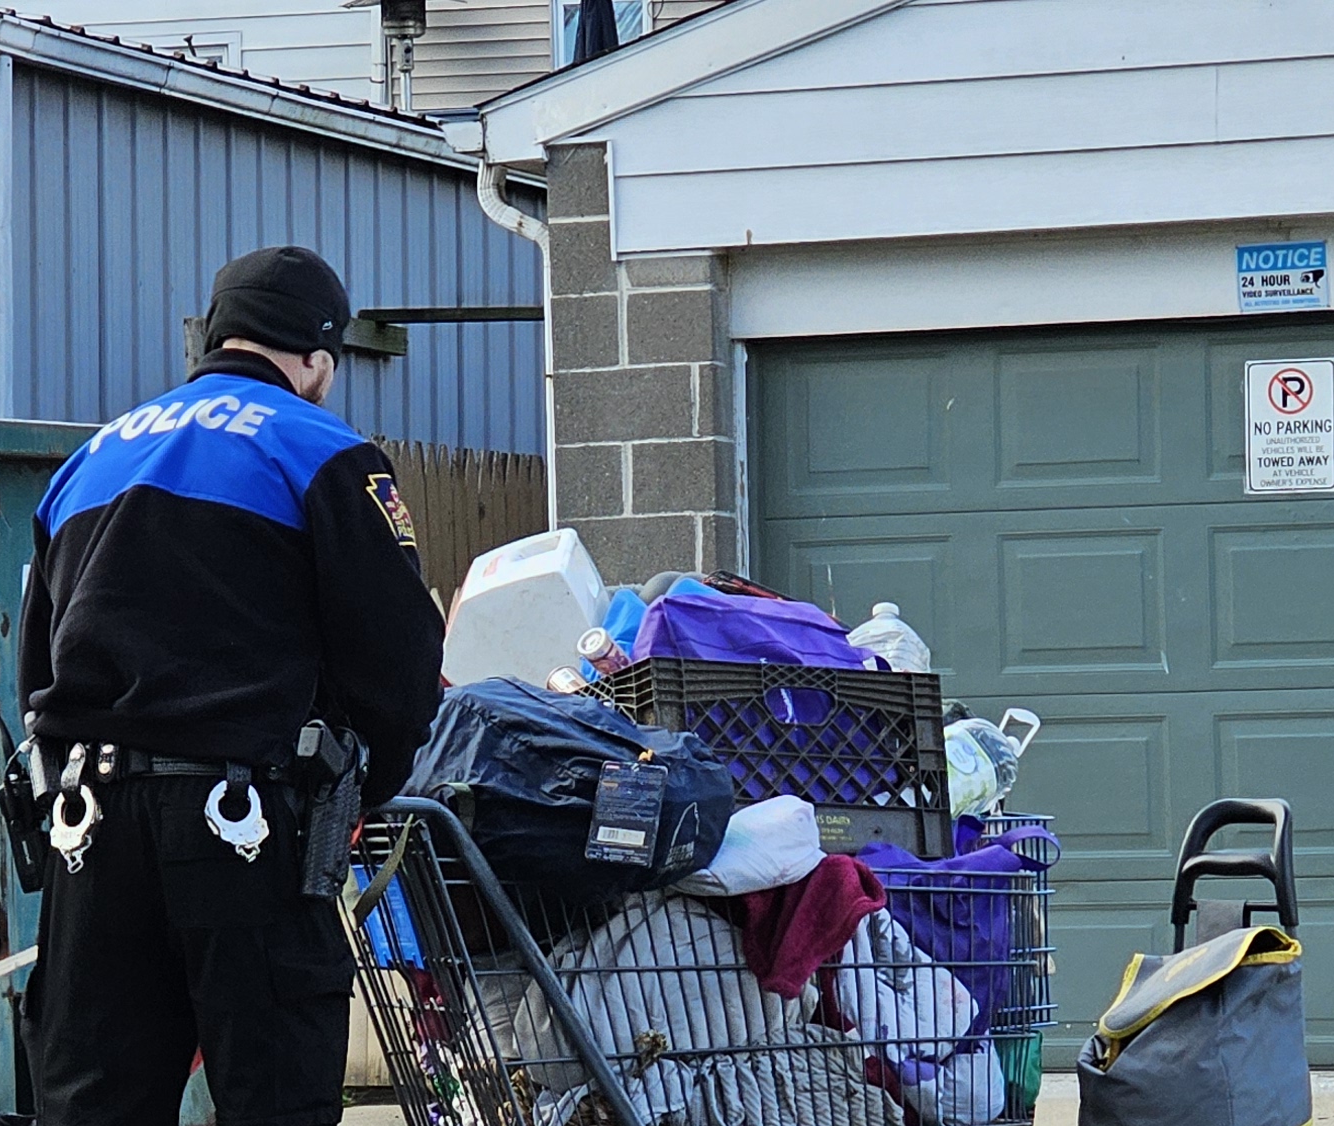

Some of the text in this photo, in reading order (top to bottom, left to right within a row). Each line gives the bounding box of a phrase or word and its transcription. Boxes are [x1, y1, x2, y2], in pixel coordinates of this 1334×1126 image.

[1241, 247, 1323, 270] NOTICE
[1241, 274, 1291, 288] 24 HOUR
[1242, 287, 1314, 298] VIDEO SURVEILLANCE
[89, 395, 277, 455] POLICE
[1254, 419, 1332, 436] NO PARKING
[1266, 436, 1320, 445] UNAUTHORIZED
[1261, 446, 1295, 455] VEHICLES
[1315, 445, 1325, 453] BE
[1257, 455, 1329, 468] TOWED AWAY
[1272, 468, 1315, 477] AT VEHICLE
[1260, 477, 1328, 487] OWNER'S EXPENSE
